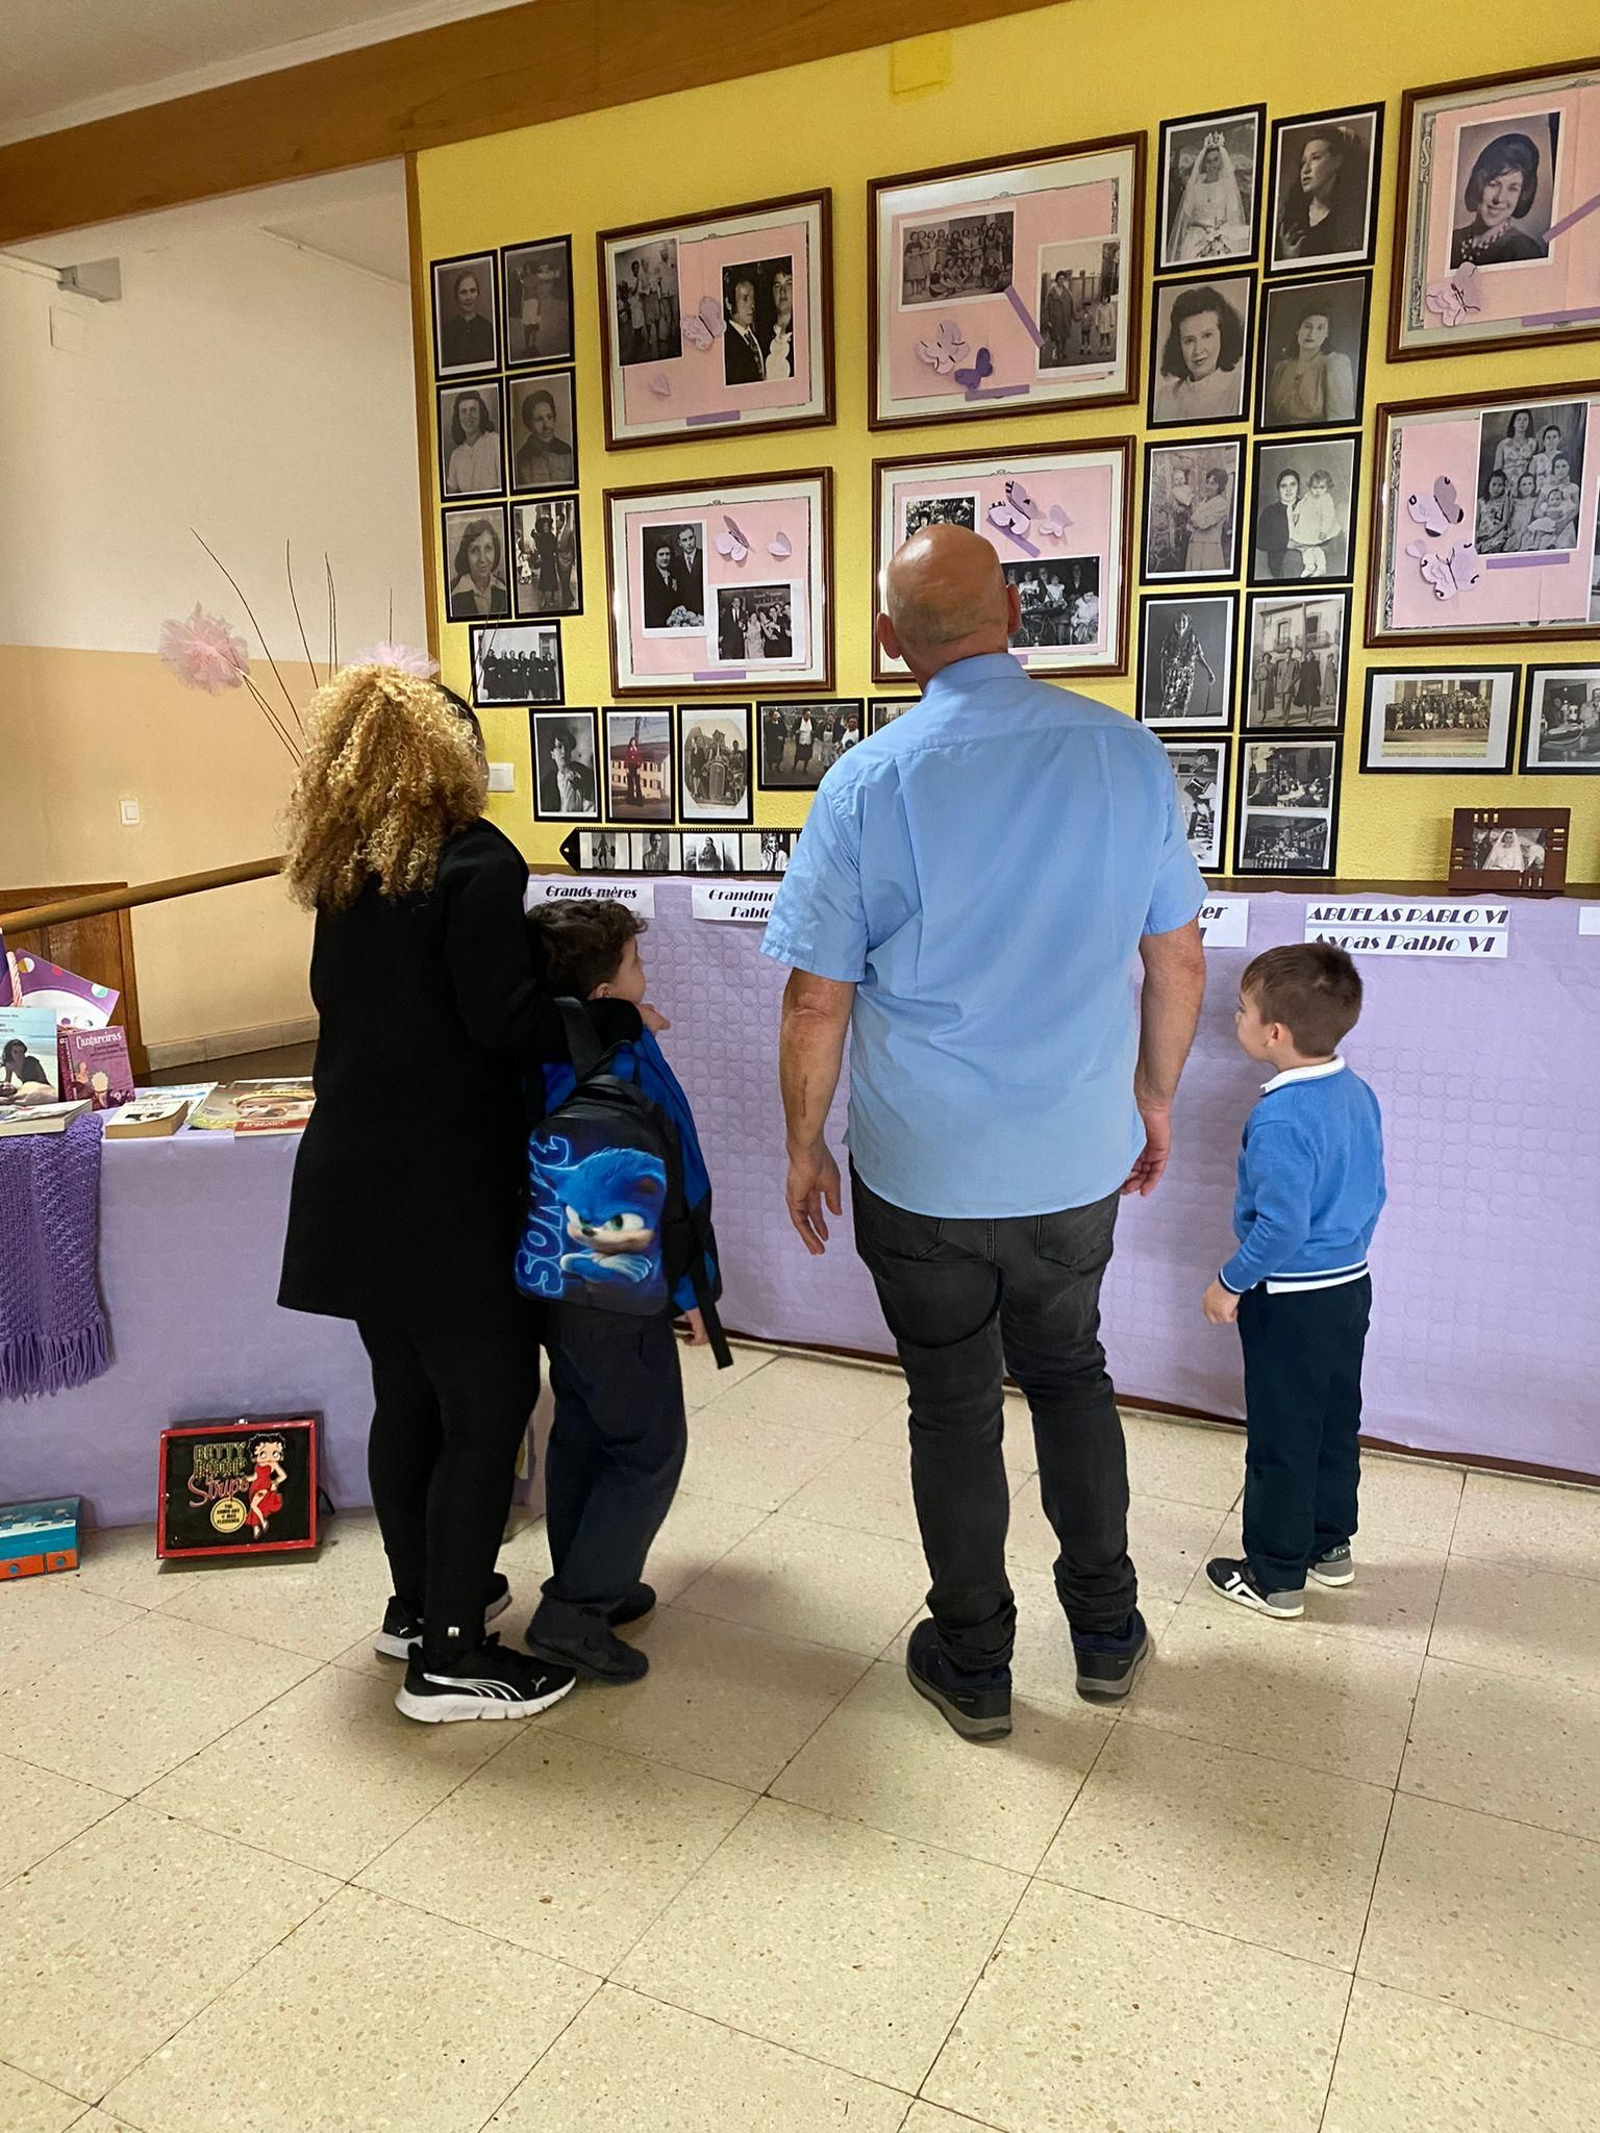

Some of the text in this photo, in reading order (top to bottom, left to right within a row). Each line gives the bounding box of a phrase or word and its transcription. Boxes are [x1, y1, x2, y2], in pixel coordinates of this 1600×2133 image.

[545, 884, 638, 899] Grands-mères
[708, 888, 777, 902] Grandmo
[1307, 907, 1509, 924] ABUELAS PABLO VI
[1386, 934, 1460, 951] Pablo
[1468, 936, 1496, 952] VI
[76, 1031, 122, 1050] Cantareiras
